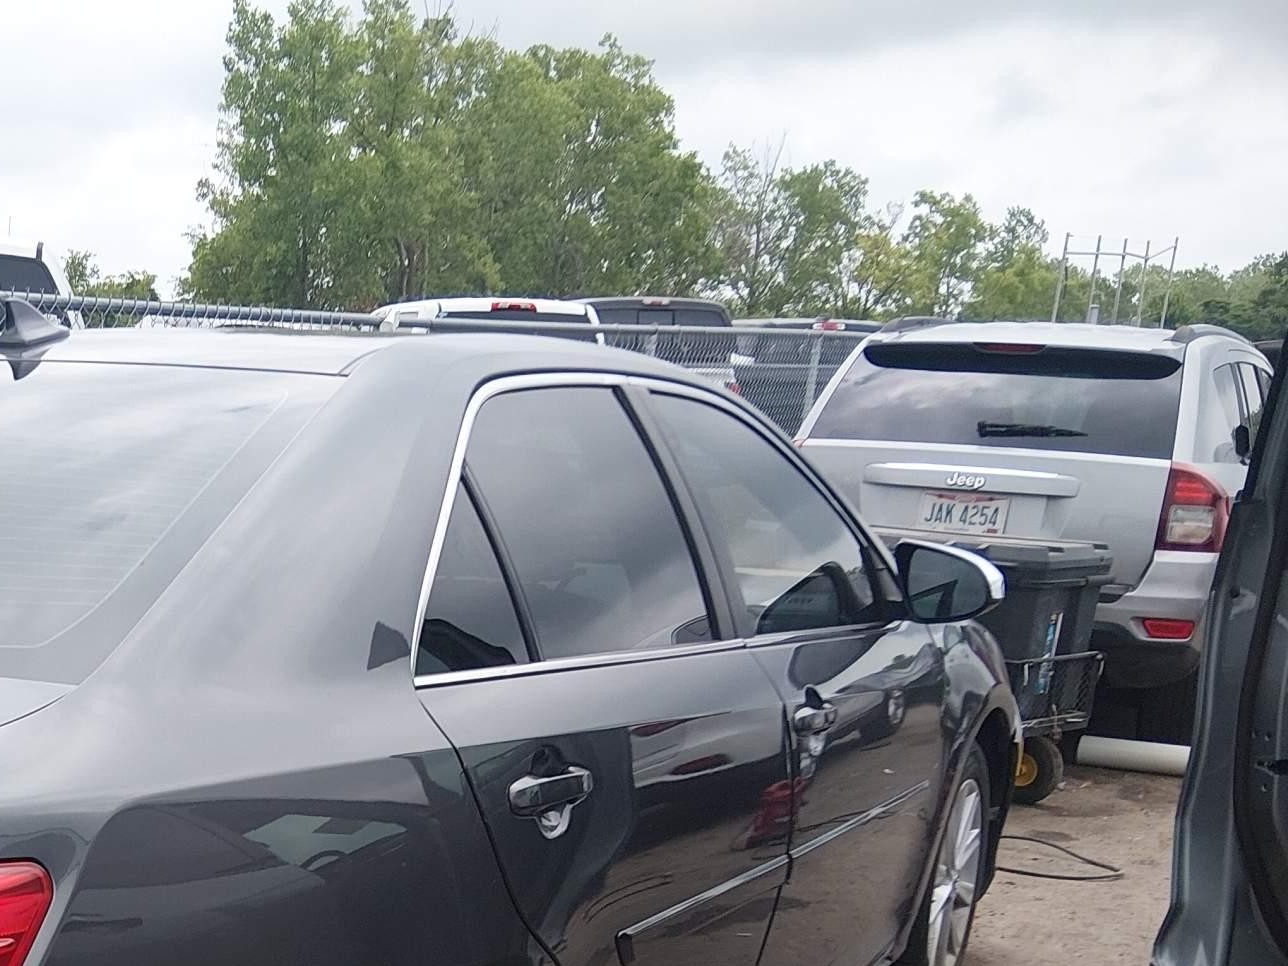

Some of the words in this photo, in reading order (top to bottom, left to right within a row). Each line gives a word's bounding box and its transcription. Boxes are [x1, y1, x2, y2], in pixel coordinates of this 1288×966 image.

[946, 472, 986, 491] Jeep
[924, 503, 956, 523] JAK
[959, 504, 1000, 527] 4254
